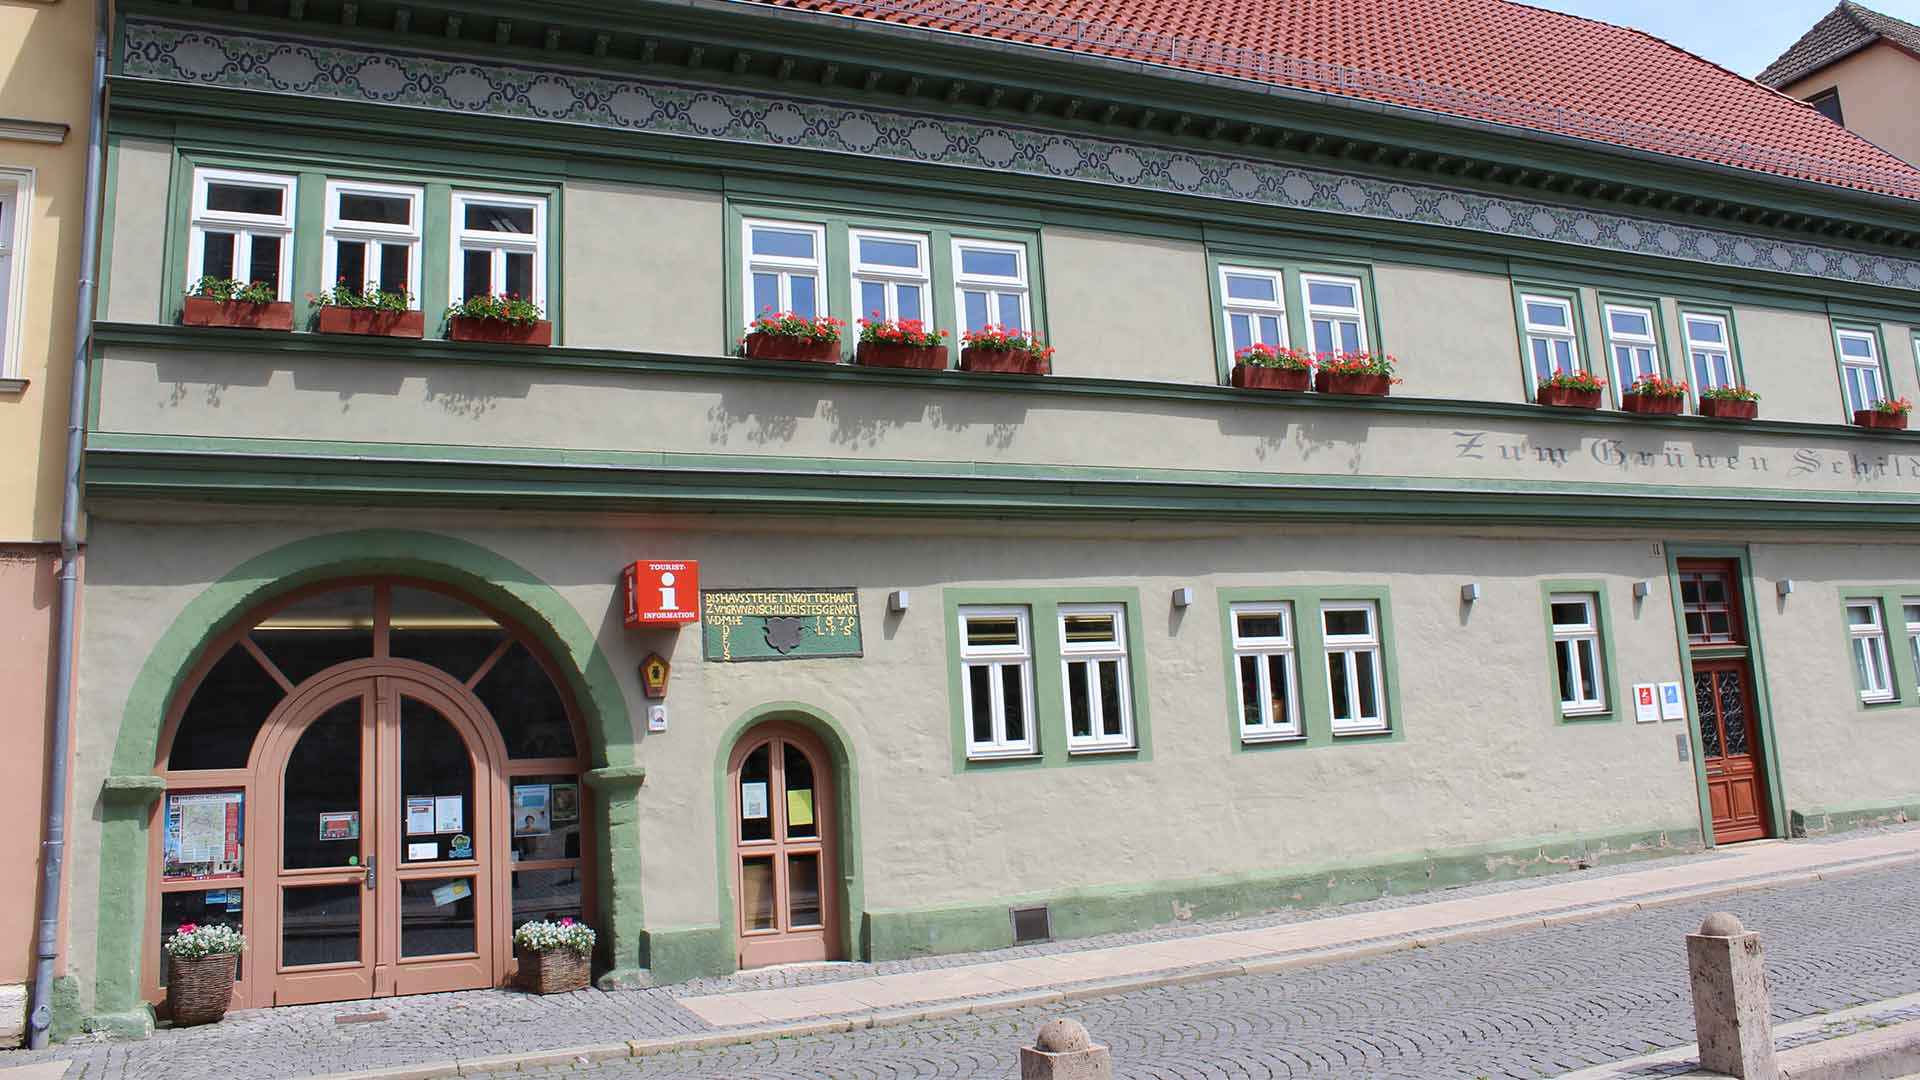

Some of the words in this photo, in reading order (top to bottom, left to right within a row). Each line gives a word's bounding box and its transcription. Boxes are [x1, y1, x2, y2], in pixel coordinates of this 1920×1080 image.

[1451, 431, 1569, 464] Zum
[1591, 438, 1769, 472] Grünen
[643, 611, 695, 620] INFORMATION
